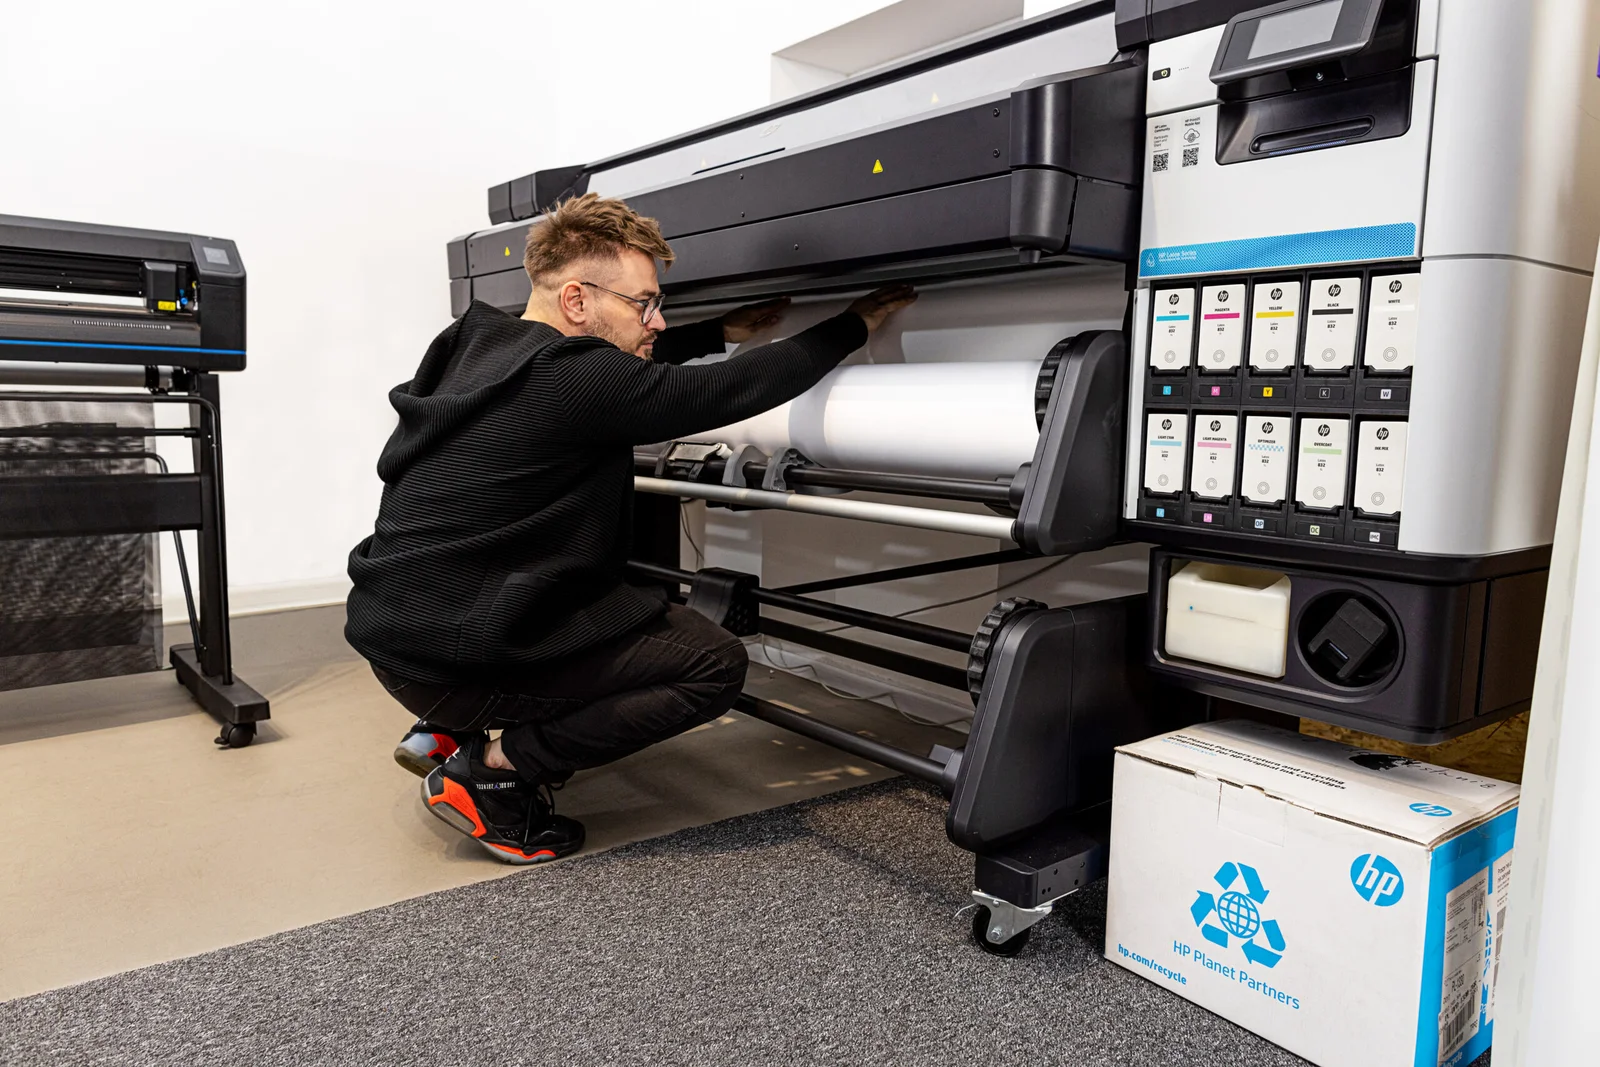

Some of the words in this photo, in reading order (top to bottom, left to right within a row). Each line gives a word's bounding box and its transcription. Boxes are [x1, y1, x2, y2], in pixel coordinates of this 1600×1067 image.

[1328, 284, 1341, 297] hp
[1389, 280, 1402, 293] hp
[1169, 293, 1179, 305] hp
[1218, 290, 1229, 302] hp
[1271, 288, 1283, 300] hp
[1162, 419, 1172, 430] hp
[1210, 420, 1221, 432] hp
[1262, 422, 1274, 434] hp
[1318, 424, 1330, 437] hp
[1376, 427, 1389, 440] hp
[1167, 736, 1216, 752] programme
[1243, 757, 1280, 771] Original
[1296, 774, 1346, 790] cartridges
[1188, 737, 1214, 747] Planet
[1214, 745, 1251, 758] Partners
[1252, 756, 1281, 767] return
[1300, 770, 1345, 785] recycling
[1411, 803, 1451, 817] hp
[1353, 854, 1402, 906] hp
[1118, 943, 1188, 986] hp.com/recycle
[1173, 939, 1191, 957] HP
[1194, 949, 1236, 981] Planet
[1239, 970, 1301, 1010] Partners
